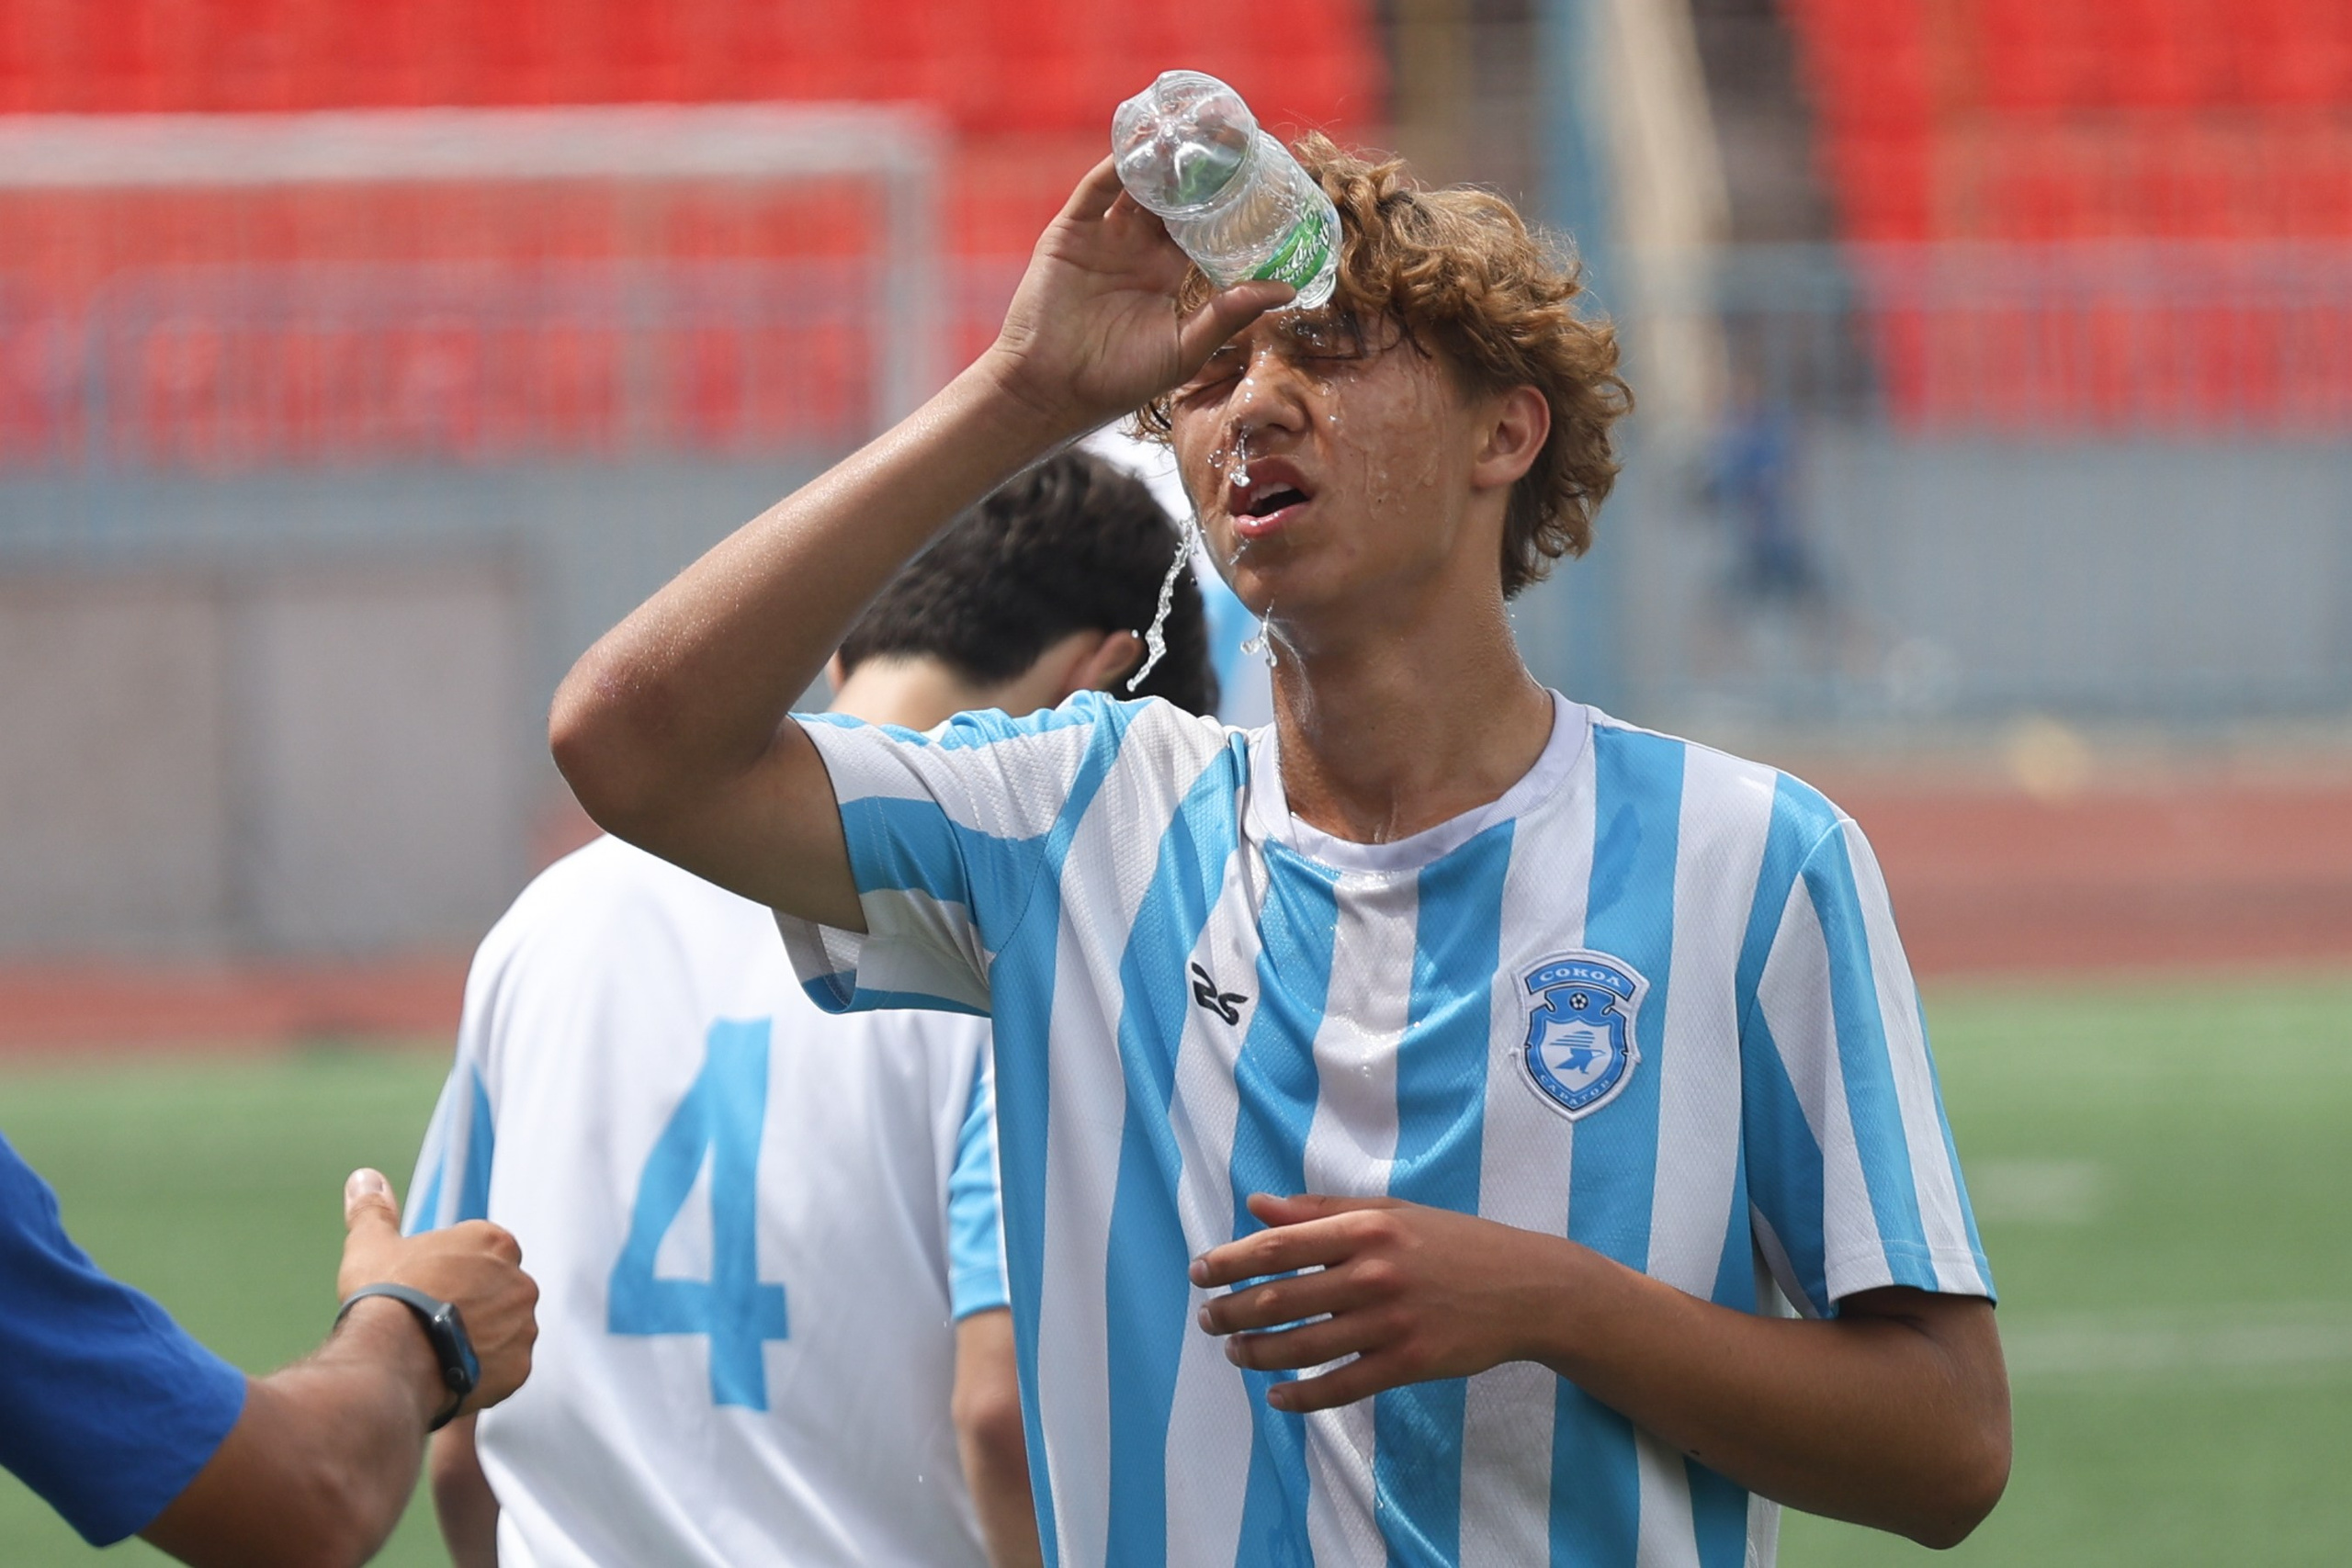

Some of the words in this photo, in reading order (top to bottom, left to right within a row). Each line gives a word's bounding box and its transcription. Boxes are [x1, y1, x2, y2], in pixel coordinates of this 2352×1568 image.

[1539, 967, 1621, 987] СОКОЛ
[1540, 1074, 1611, 1106] САРАТОВ
[605, 1015, 789, 1412] 4
